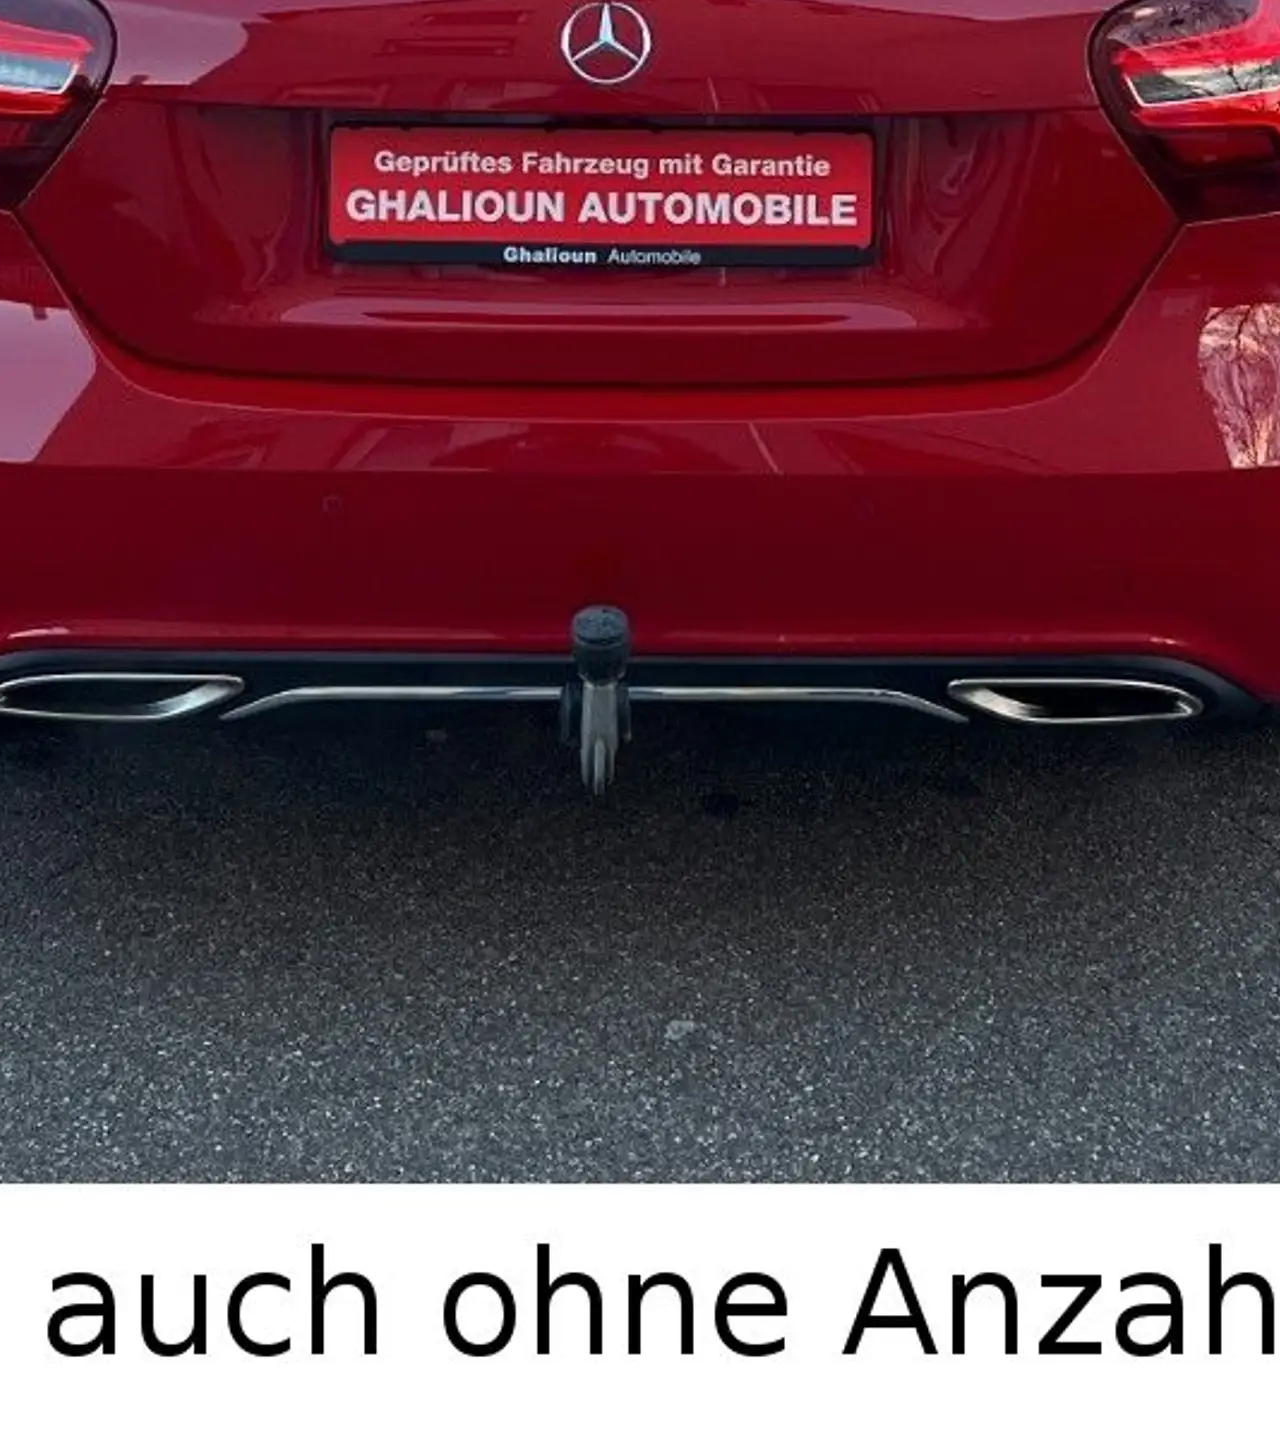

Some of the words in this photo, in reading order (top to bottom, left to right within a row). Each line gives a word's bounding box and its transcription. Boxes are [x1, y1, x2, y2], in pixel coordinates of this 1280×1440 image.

[373, 150, 514, 178] Geprüftes
[522, 151, 649, 180] Fahrzeug
[658, 152, 703, 176] mit
[711, 153, 831, 177] Garantie
[345, 189, 566, 224] GHALIOUN
[577, 191, 858, 226] AUTOMOBILE
[502, 246, 597, 264] Ghalioun
[607, 247, 702, 265] Automobile
